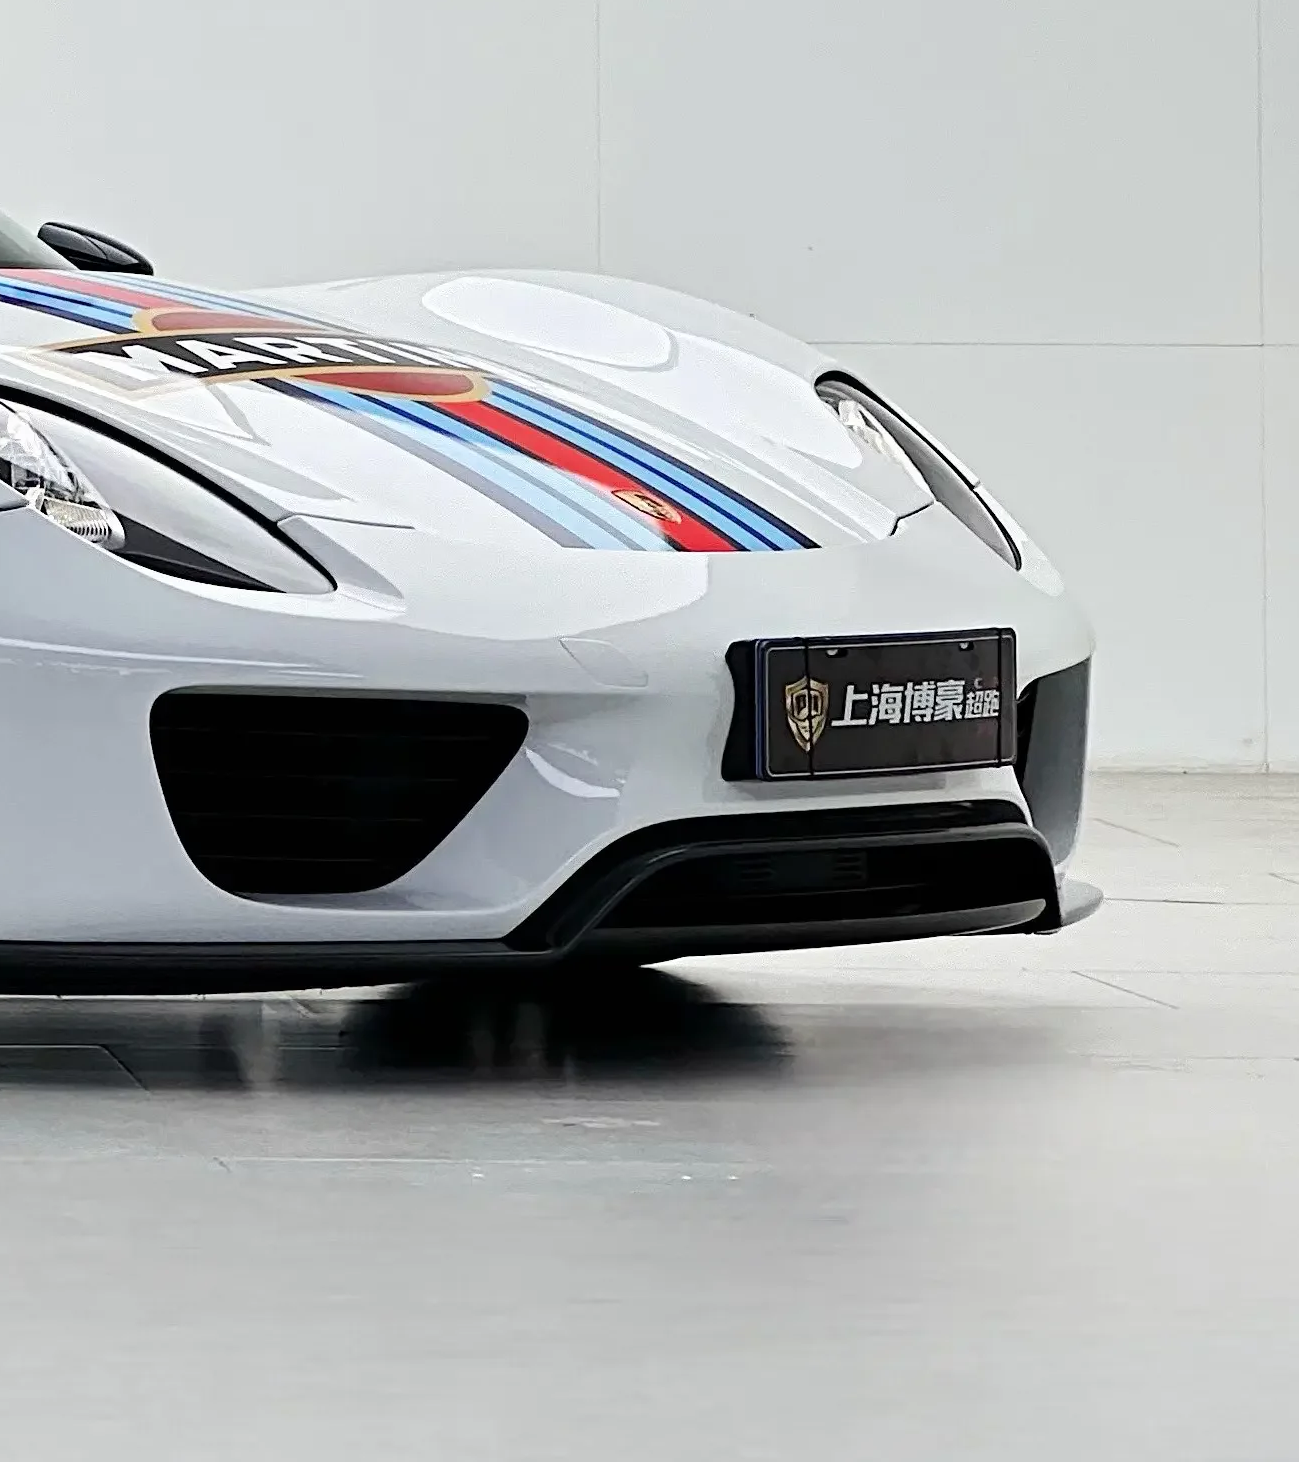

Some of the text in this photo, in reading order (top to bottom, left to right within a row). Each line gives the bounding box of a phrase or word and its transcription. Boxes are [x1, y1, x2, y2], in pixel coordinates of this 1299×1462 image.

[79, 336, 496, 381] MARTIN
[831, 679, 966, 726] 上海博豪
